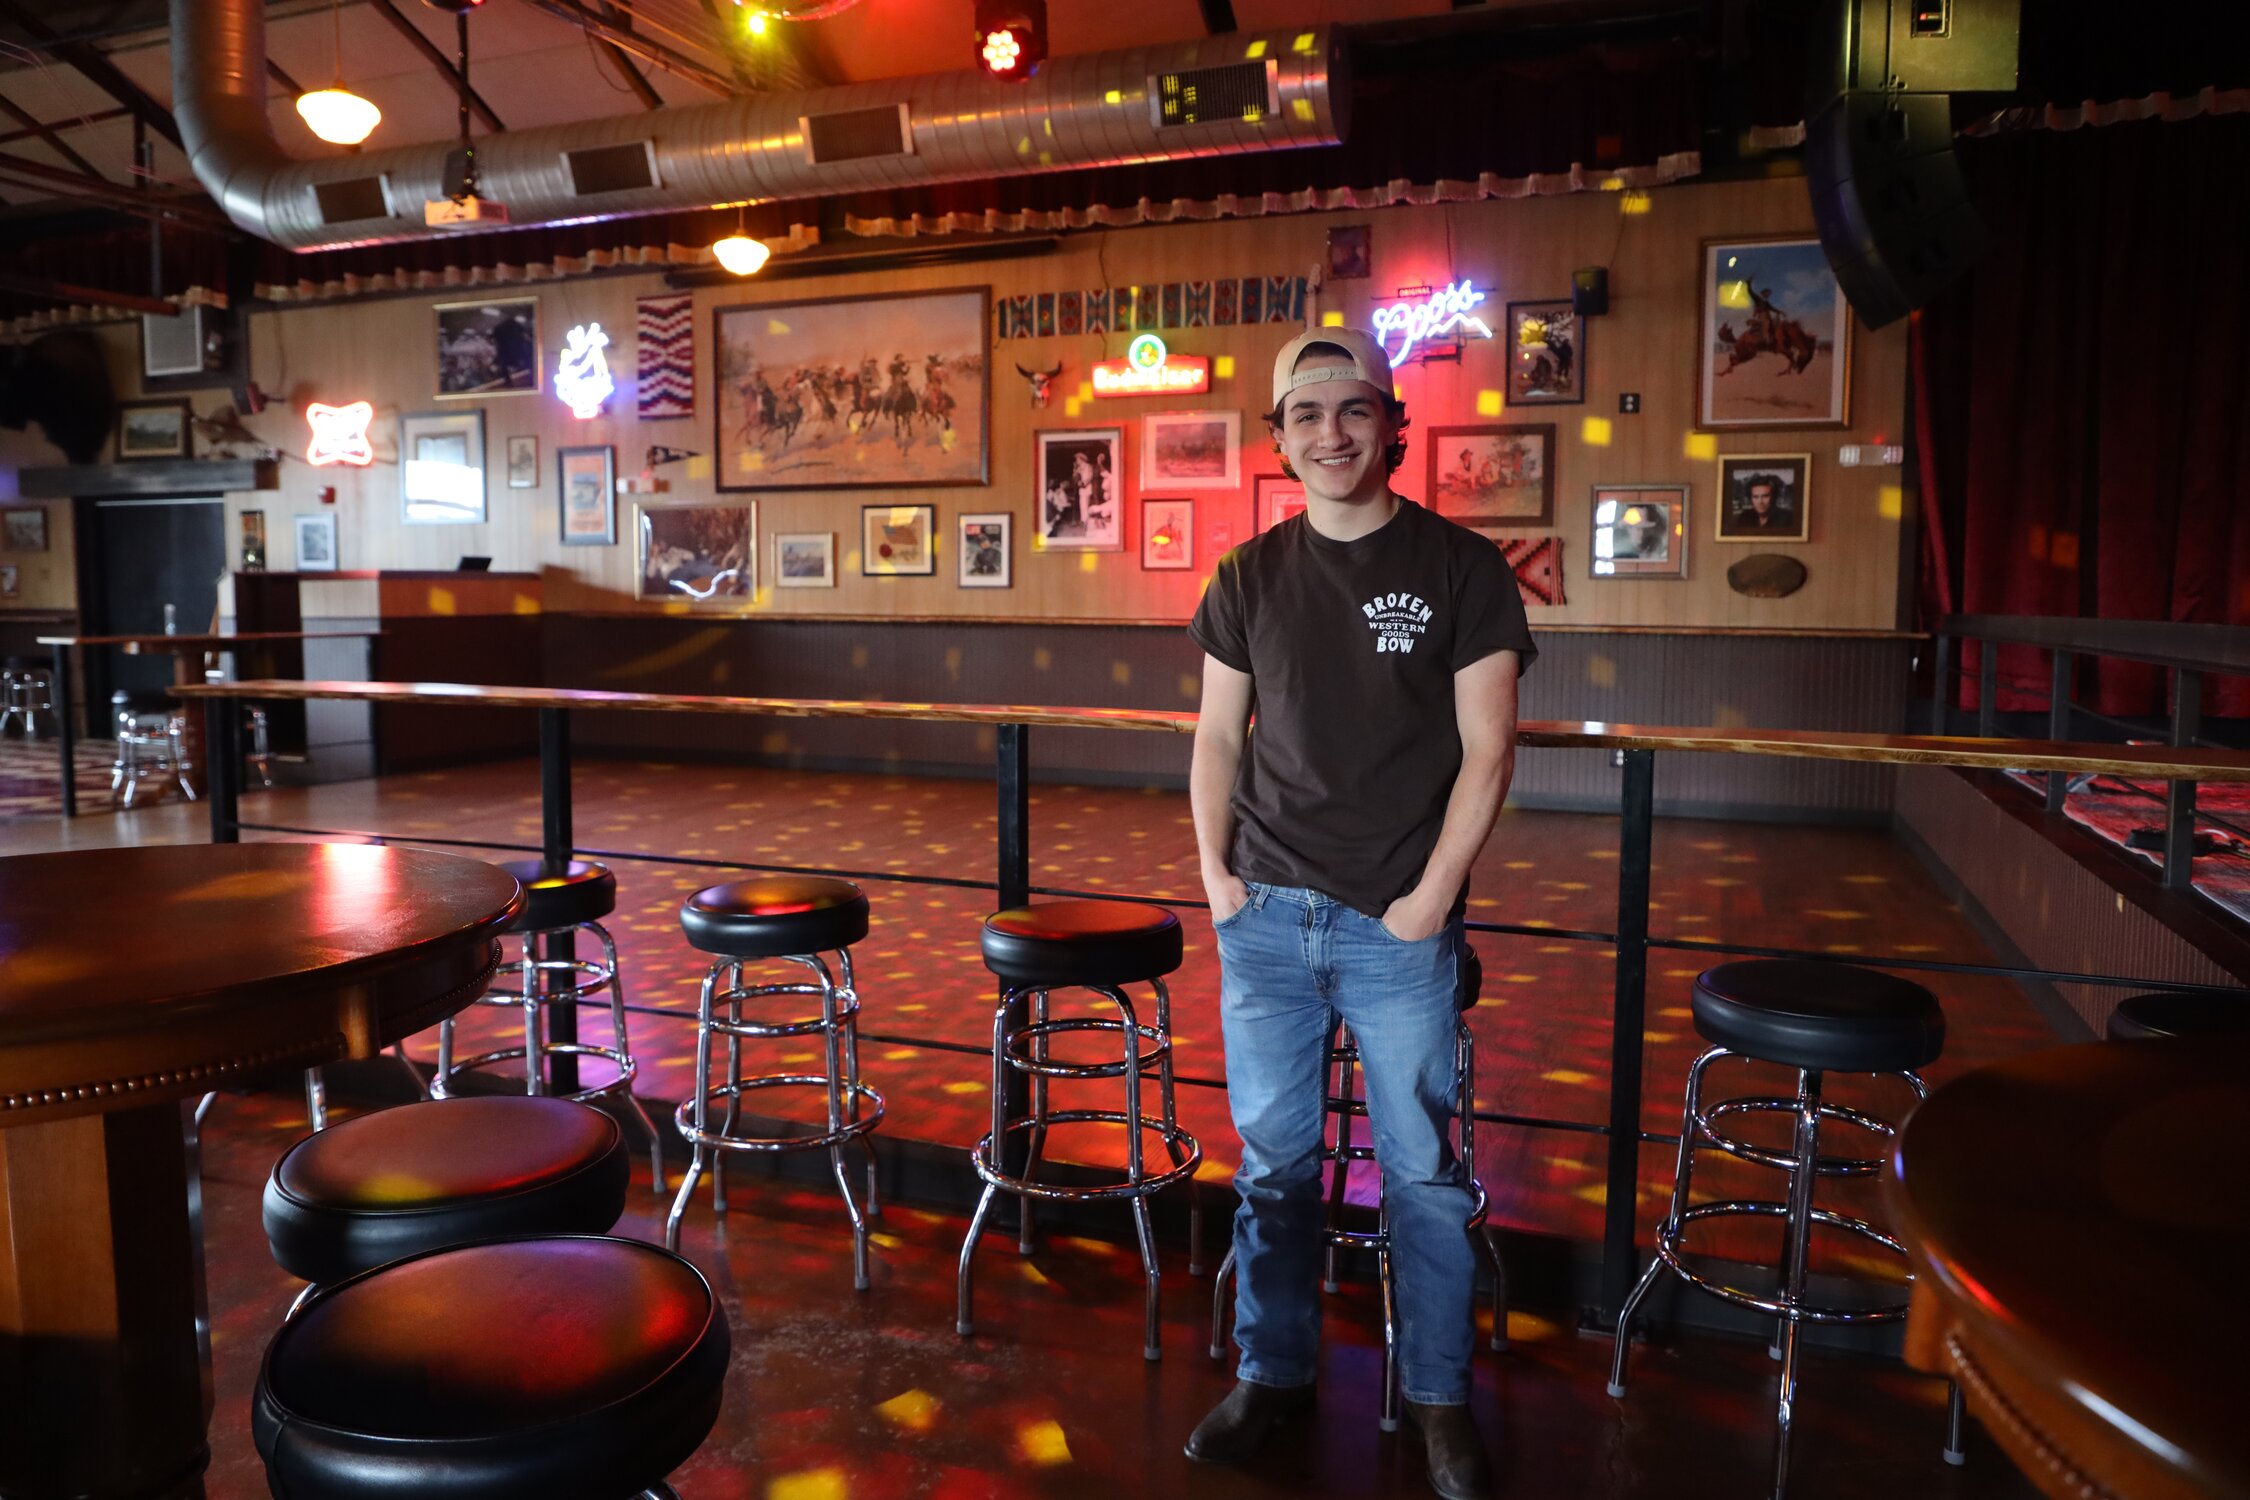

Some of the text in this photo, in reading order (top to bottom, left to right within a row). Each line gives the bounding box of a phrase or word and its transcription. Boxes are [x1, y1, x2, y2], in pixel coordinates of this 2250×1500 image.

[1362, 592, 1433, 623] BROKEN
[1374, 611, 1421, 622] UNBREAKABLE
[1369, 622, 1426, 634] WESTERN
[1381, 630, 1410, 638] GOODS
[1377, 636, 1415, 654] BOW
